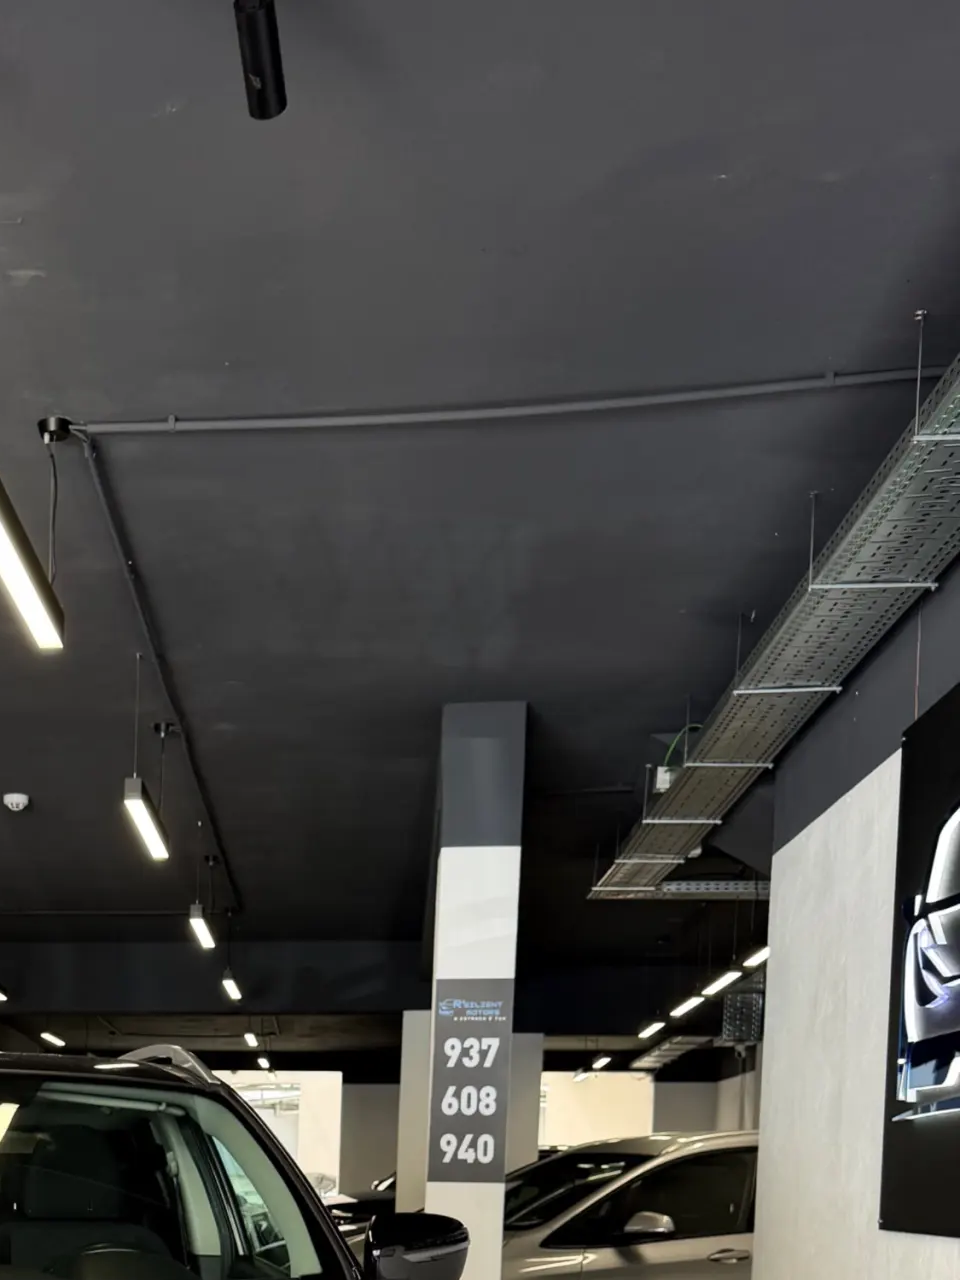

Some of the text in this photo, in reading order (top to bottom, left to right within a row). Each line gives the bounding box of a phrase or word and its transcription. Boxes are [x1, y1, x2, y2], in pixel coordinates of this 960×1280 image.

[443, 1037, 500, 1068] 937
[441, 1085, 497, 1116] 608
[439, 1133, 495, 1164] 940
